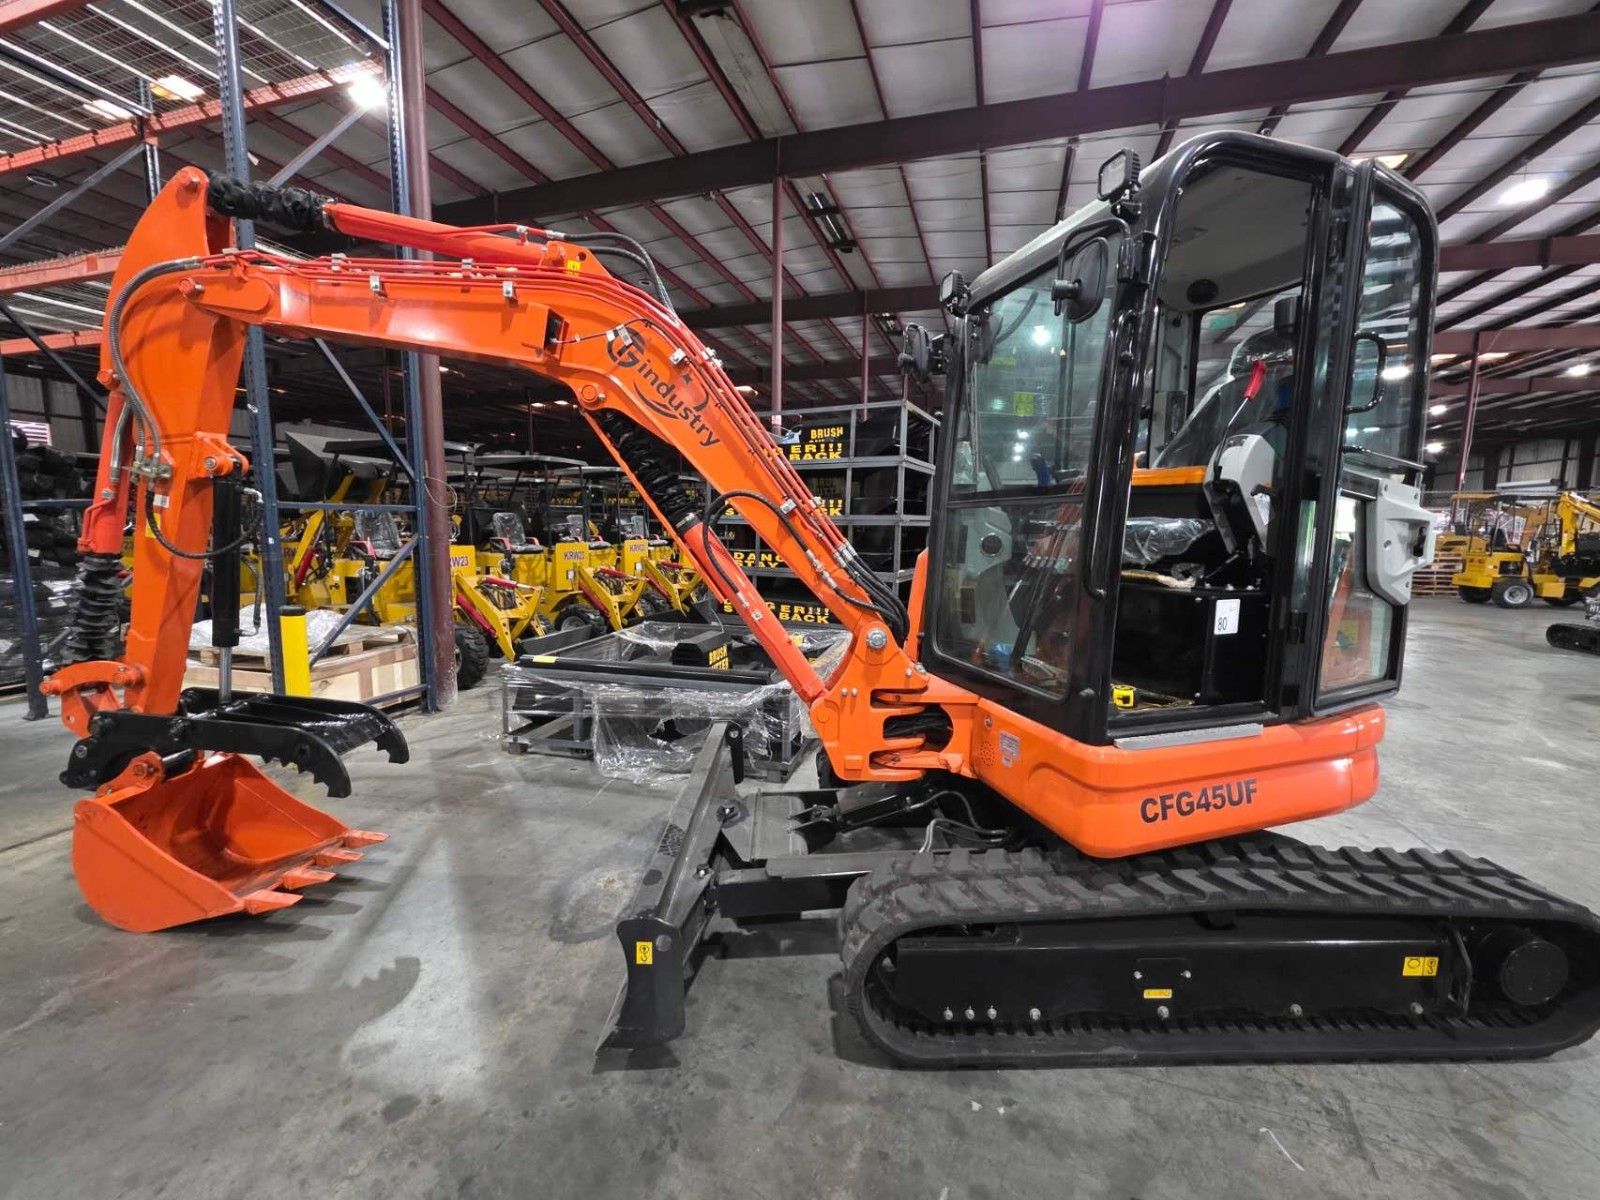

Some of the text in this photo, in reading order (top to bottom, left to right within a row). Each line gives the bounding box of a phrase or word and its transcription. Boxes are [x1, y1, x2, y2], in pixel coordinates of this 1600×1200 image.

[637, 359, 721, 447] industry
[810, 427, 844, 440] BRUSH
[789, 452, 842, 460] BACK
[564, 551, 586, 560] KRW23
[778, 612, 830, 624] BACK
[1217, 616, 1228, 631] 80
[1140, 779, 1257, 824] CFG45UF
